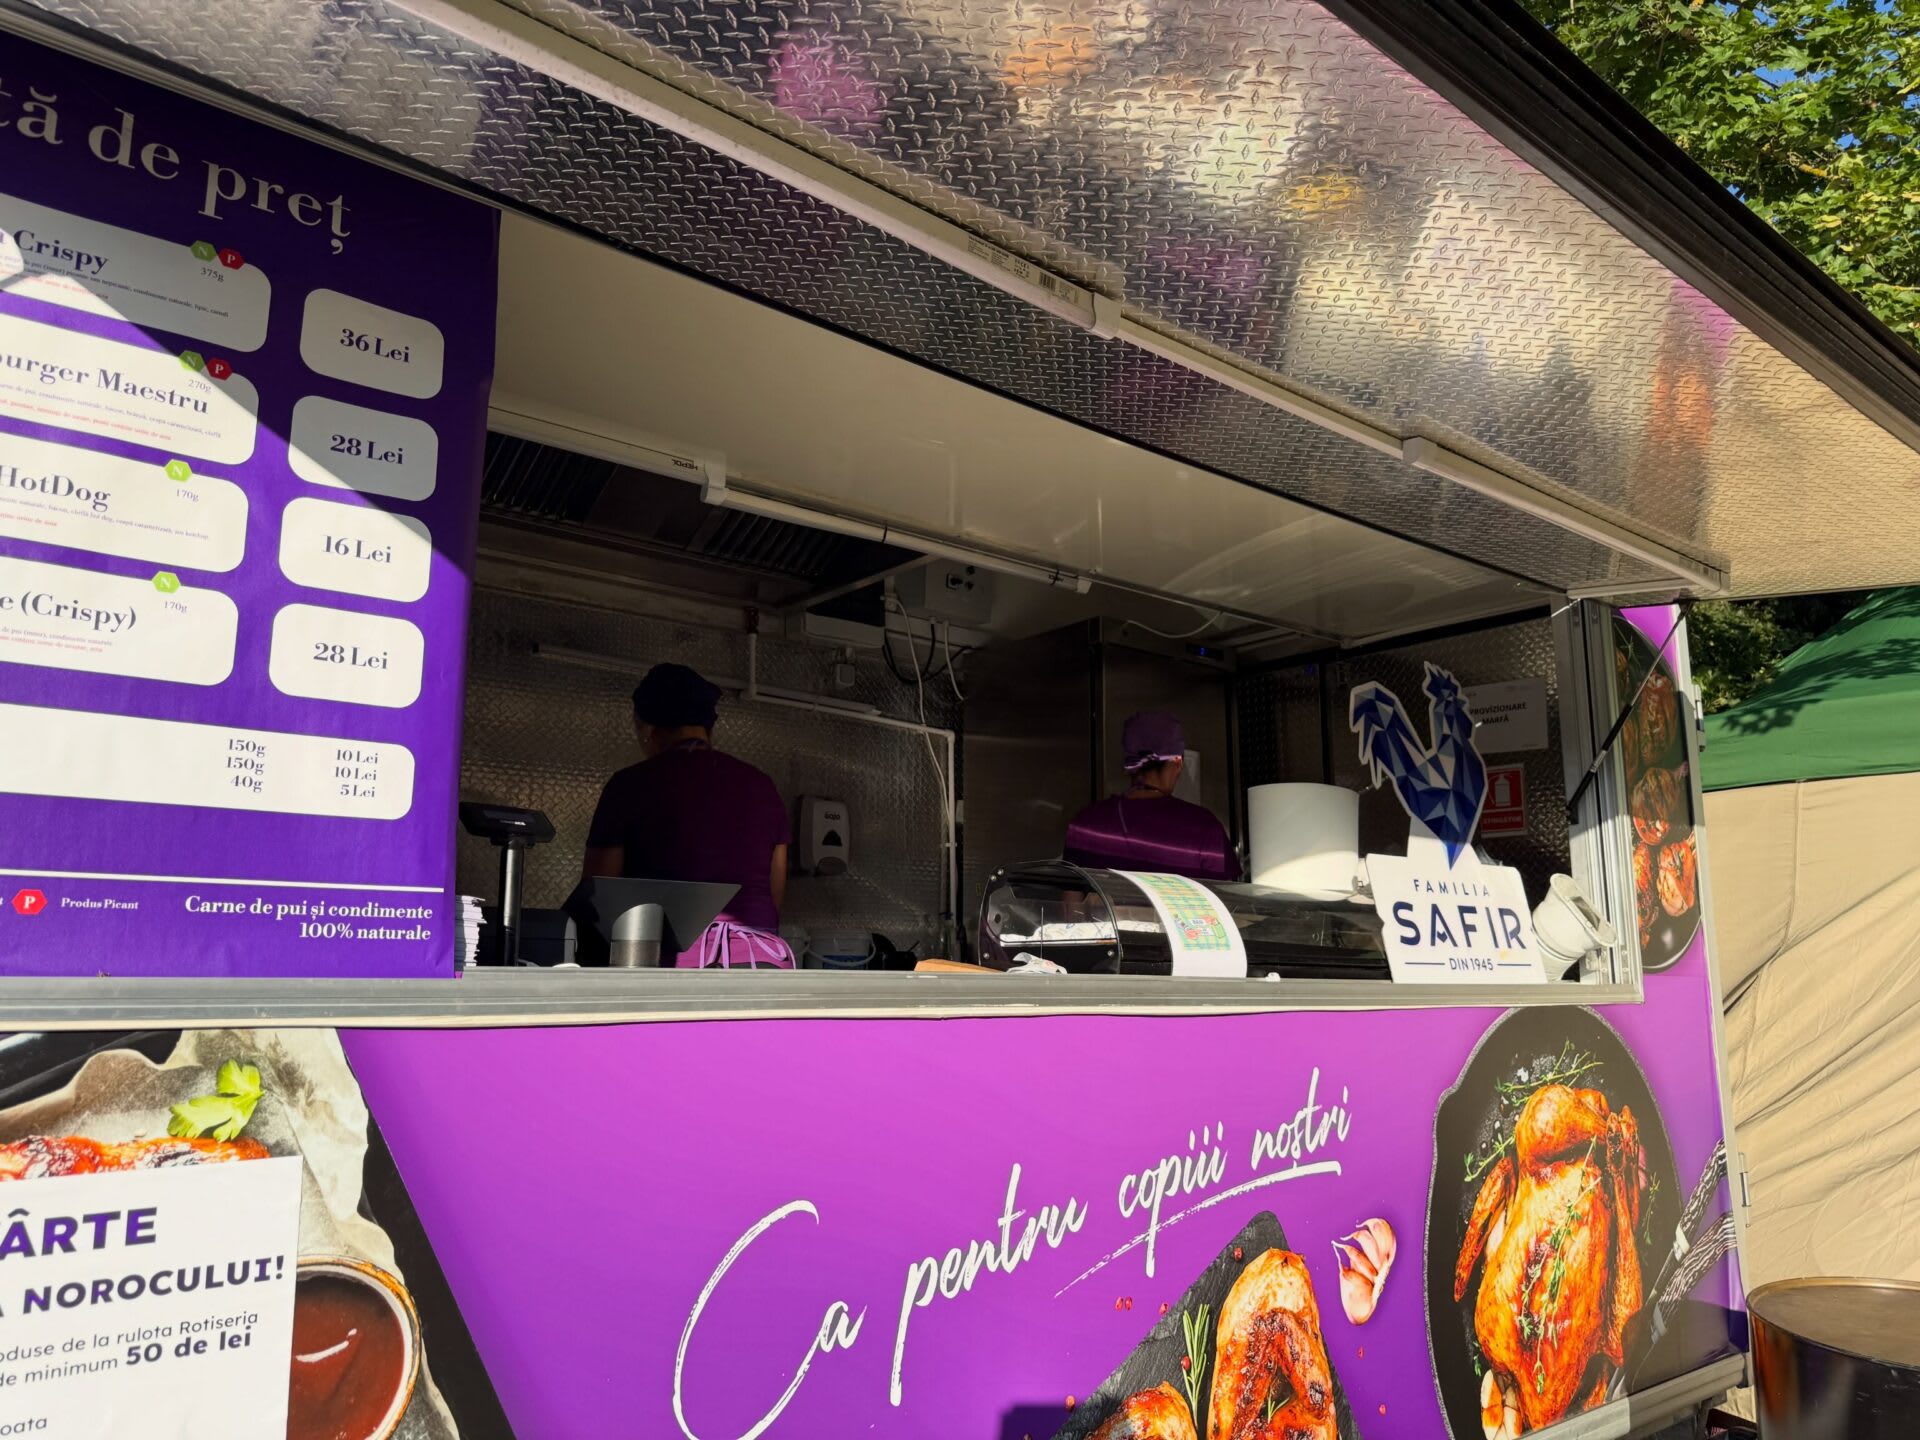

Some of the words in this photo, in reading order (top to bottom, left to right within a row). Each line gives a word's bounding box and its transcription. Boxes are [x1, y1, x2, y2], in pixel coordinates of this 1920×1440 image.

[89, 107, 180, 181] de
[198, 159, 351, 255] preț
[13, 229, 109, 275] Crispy
[227, 254, 236, 264] P
[200, 267, 225, 283] 375g
[340, 328, 370, 352] 36
[374, 337, 410, 363] Lei
[215, 364, 224, 374] P
[0, 353, 90, 385] urger
[97, 368, 209, 414] Maestru
[188, 379, 212, 394] 270g
[330, 434, 361, 456] 28
[367, 440, 403, 465] Lei
[172, 465, 183, 476] N
[0, 464, 111, 513] HotDog
[176, 488, 200, 502] 170g
[322, 535, 349, 556] 16
[355, 539, 392, 563] Lei
[160, 576, 171, 588] N
[20, 590, 137, 633] (Crispy)
[163, 600, 188, 614] 170g
[313, 642, 345, 664] 28
[351, 647, 388, 669] Lei
[228, 738, 266, 758] 150g
[336, 749, 352, 762] 10
[355, 750, 379, 764] Lei
[226, 756, 265, 776] 150g
[334, 766, 351, 779] 10
[354, 768, 377, 781] Lei
[230, 775, 263, 793] 40g
[340, 784, 350, 796] 5
[352, 785, 376, 798] Lei
[1413, 879, 1491, 897] FAMILIA
[23, 896, 36, 909] P
[61, 897, 102, 909] Produs
[104, 898, 139, 910] Picant
[185, 895, 246, 915] Carne
[249, 898, 273, 915] de
[276, 901, 308, 921] pui
[310, 901, 325, 922] și
[328, 902, 434, 920] condimente
[299, 922, 354, 940] 100%
[357, 923, 431, 941] naturale
[1392, 901, 1527, 950] SAFIR
[1449, 957, 1469, 971] DIN
[1470, 958, 1494, 971] 1945
[23, 1255, 285, 1315] NOROCULUI!
[672, 1200, 867, 1440] Ca
[889, 1163, 1088, 1407] pentru
[1118, 1122, 1229, 1279] copiii
[61, 1337, 86, 1352] de
[93, 1333, 110, 1349] la
[117, 1324, 173, 1345] rulota
[180, 1311, 258, 1335] Rotiseria
[24, 1356, 118, 1384] minimum
[126, 1343, 163, 1365] 50
[174, 1336, 208, 1358] de
[219, 1325, 252, 1351] lei
